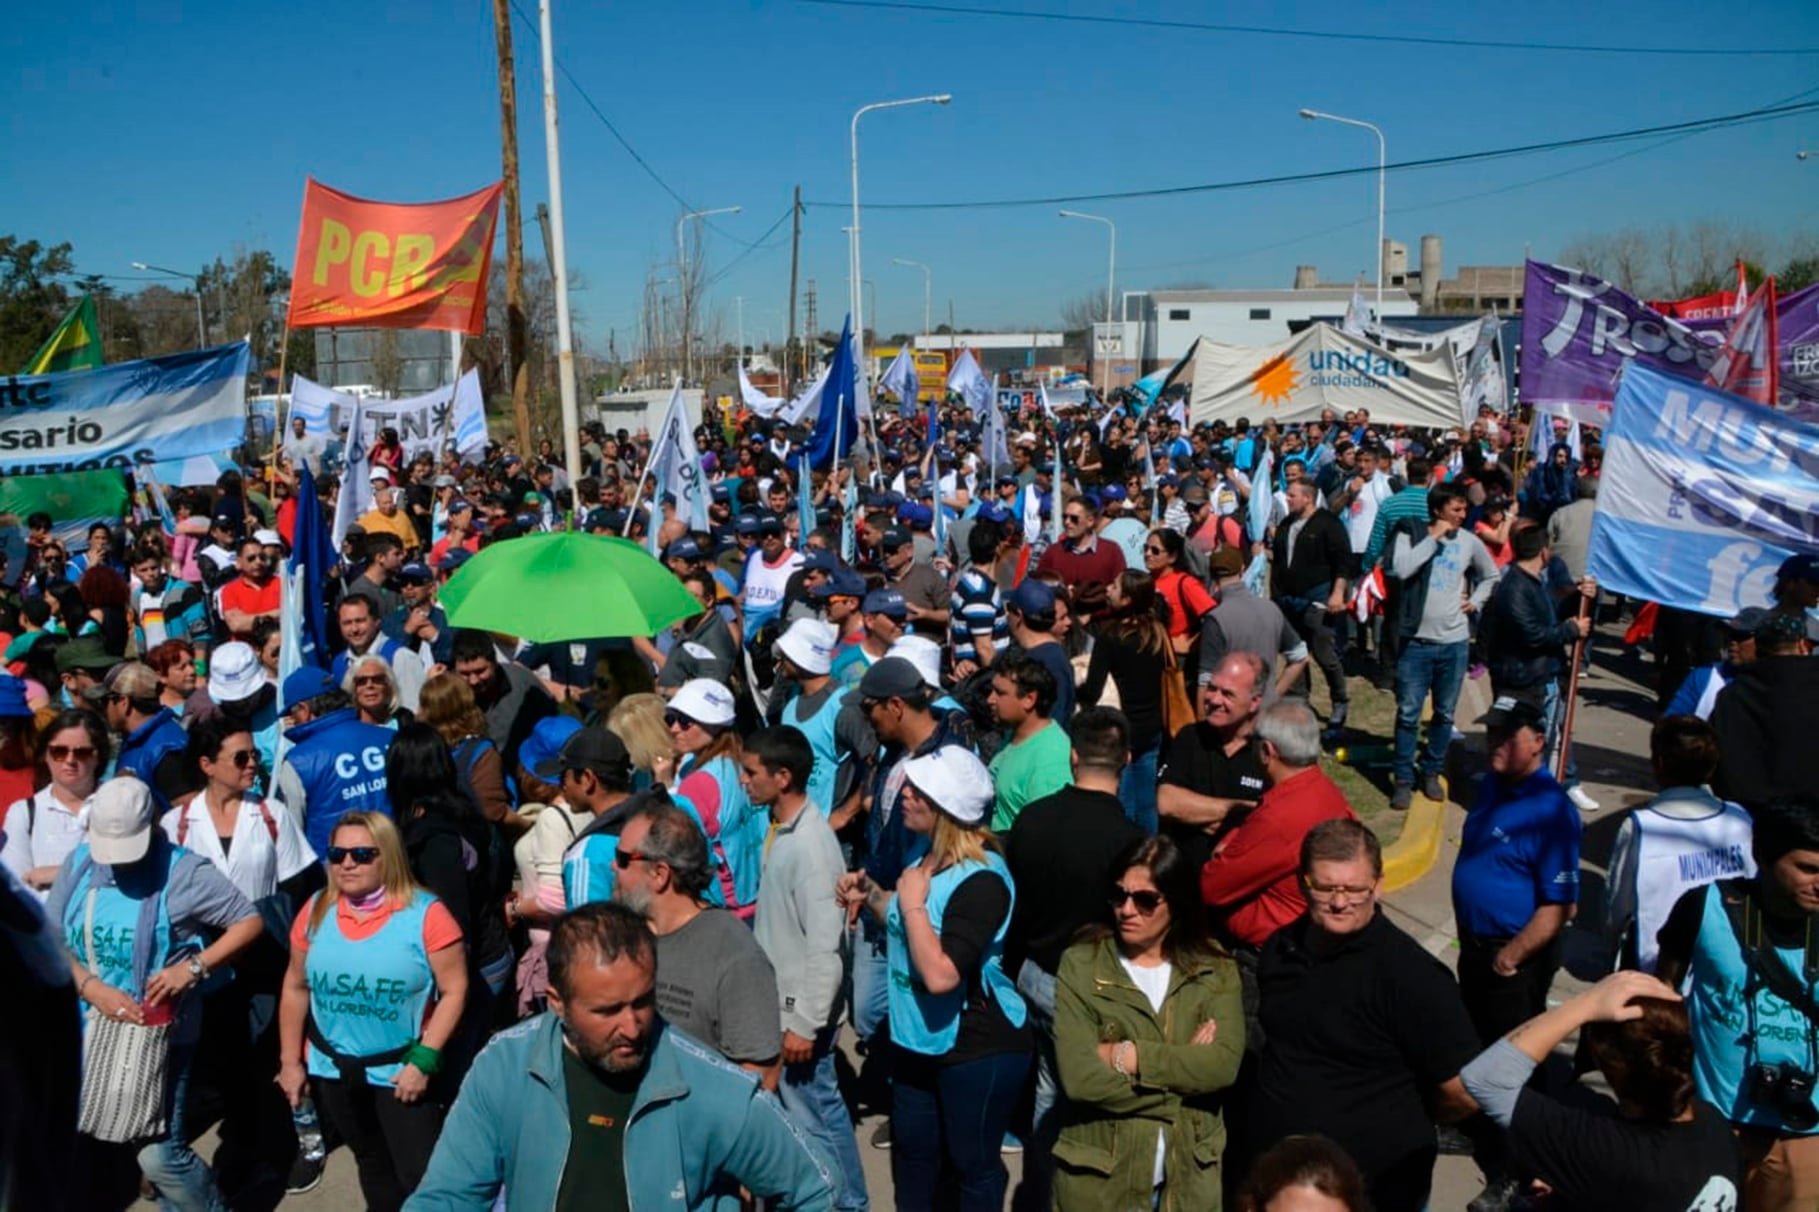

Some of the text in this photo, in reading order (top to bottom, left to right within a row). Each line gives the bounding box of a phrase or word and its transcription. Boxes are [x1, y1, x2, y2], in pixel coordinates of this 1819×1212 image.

[313, 217, 435, 299] PCR
[0, 377, 52, 407] tc
[335, 745, 390, 779] CG
[342, 782, 367, 800] SAN
[329, 1000, 400, 1022] LORENZO
[1757, 1023, 1808, 1044] OREN
